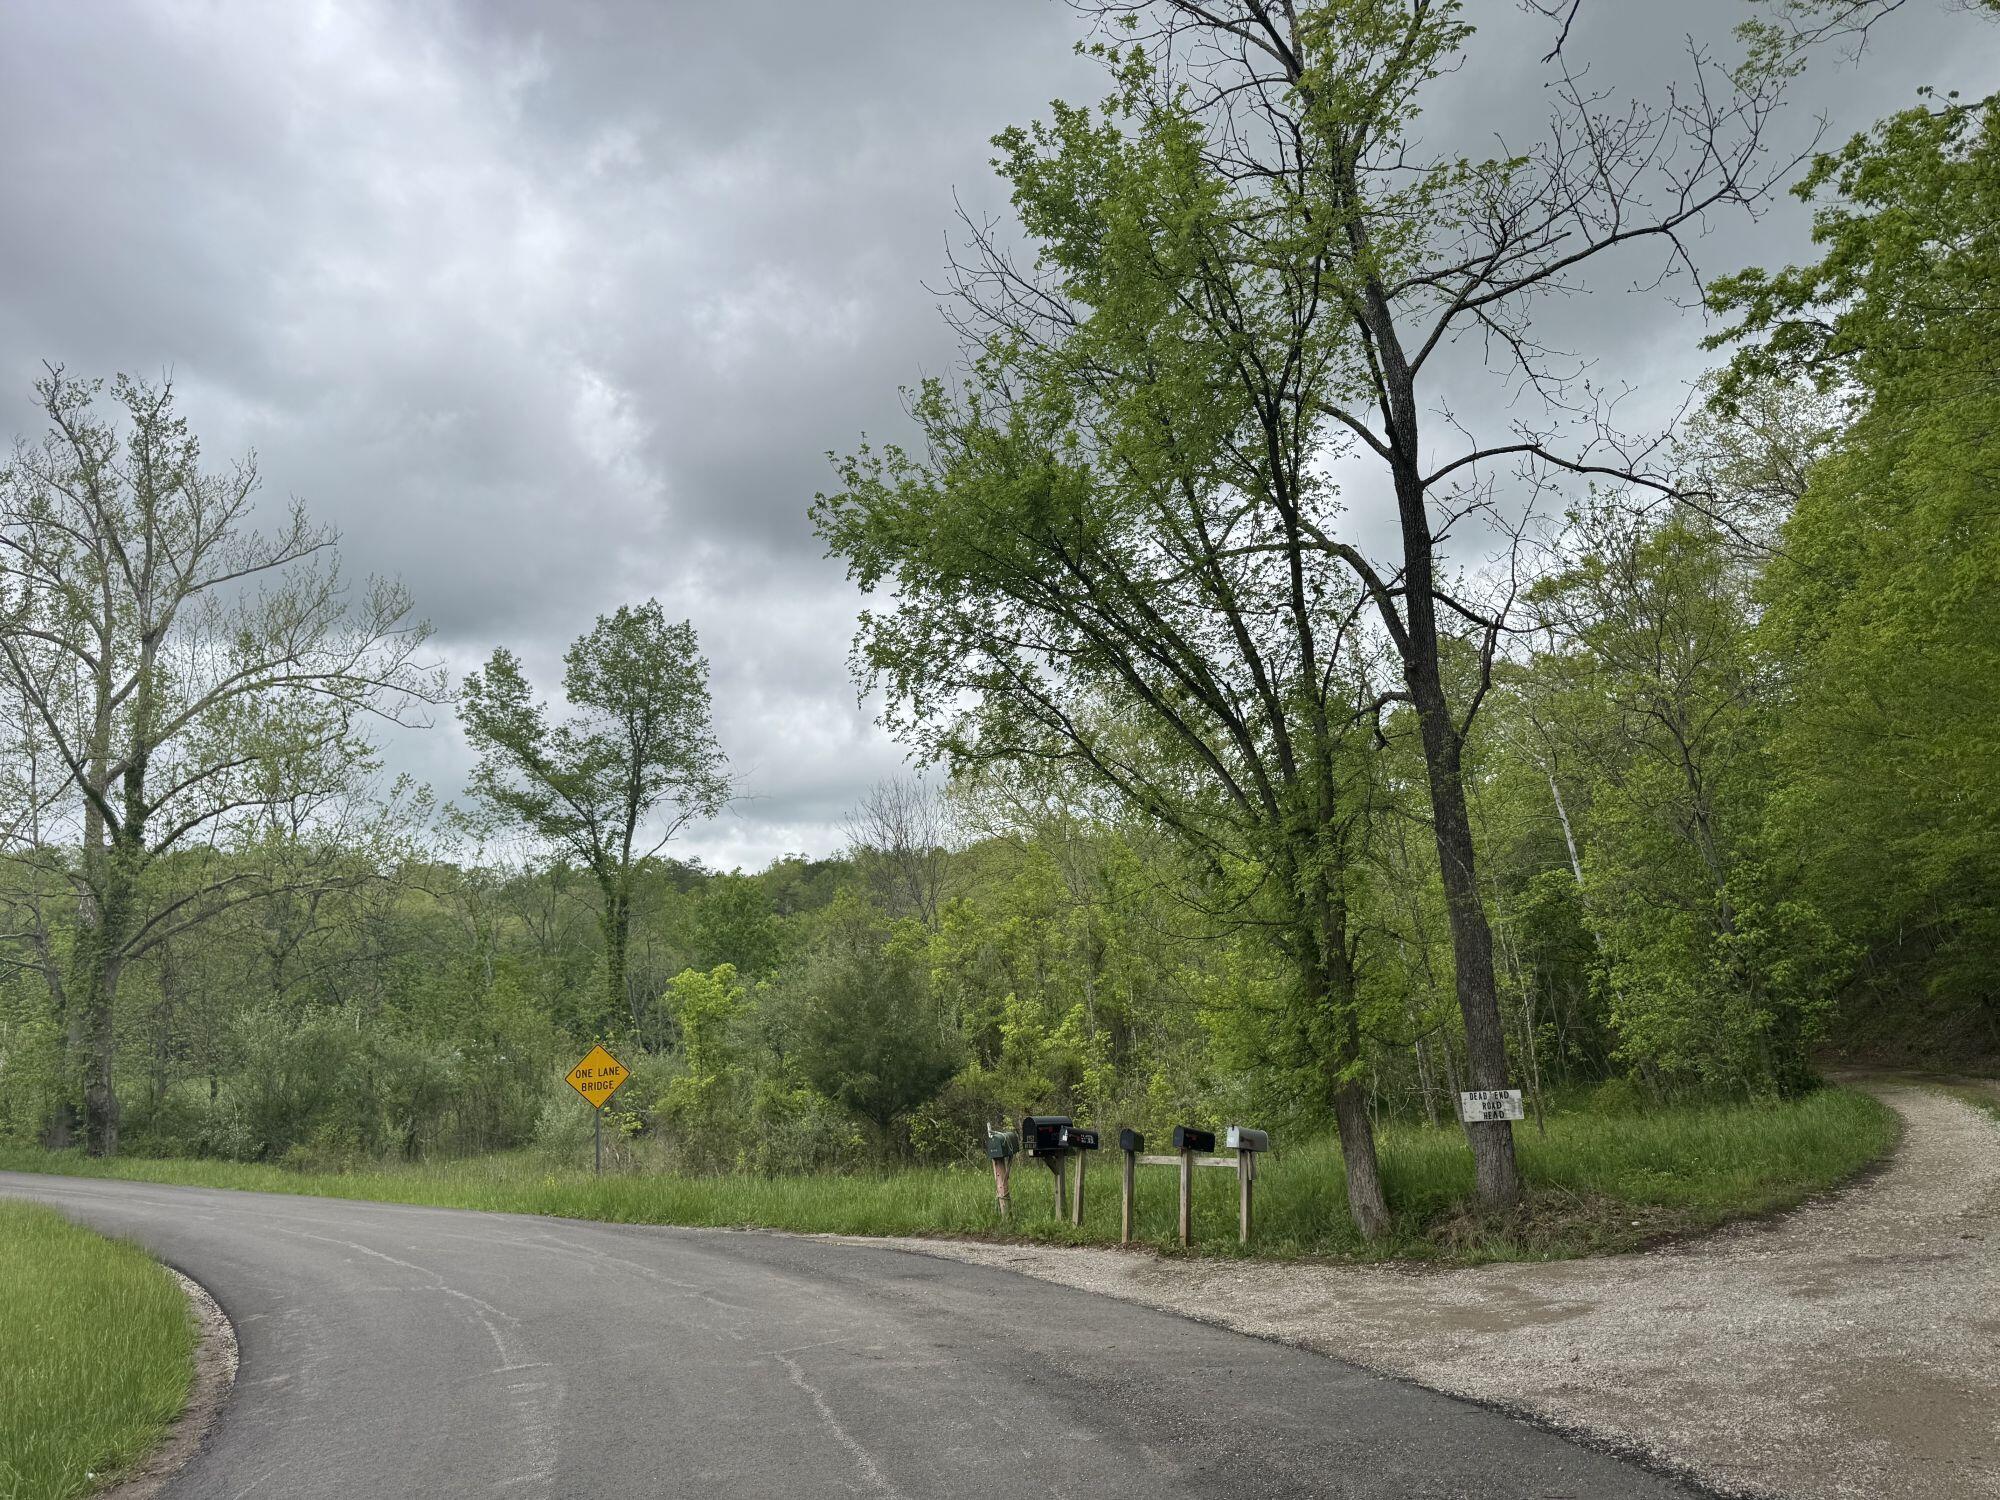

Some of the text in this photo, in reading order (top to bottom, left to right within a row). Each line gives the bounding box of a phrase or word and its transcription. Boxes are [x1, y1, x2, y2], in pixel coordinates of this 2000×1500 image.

[576, 1066, 620, 1078] ONE LANE
[582, 1080, 614, 1092] BRIDGE
[1470, 1090, 1509, 1100] DEAD END
[1482, 1102, 1502, 1110] ROAD
[1484, 1111, 1504, 1120] HEAD
